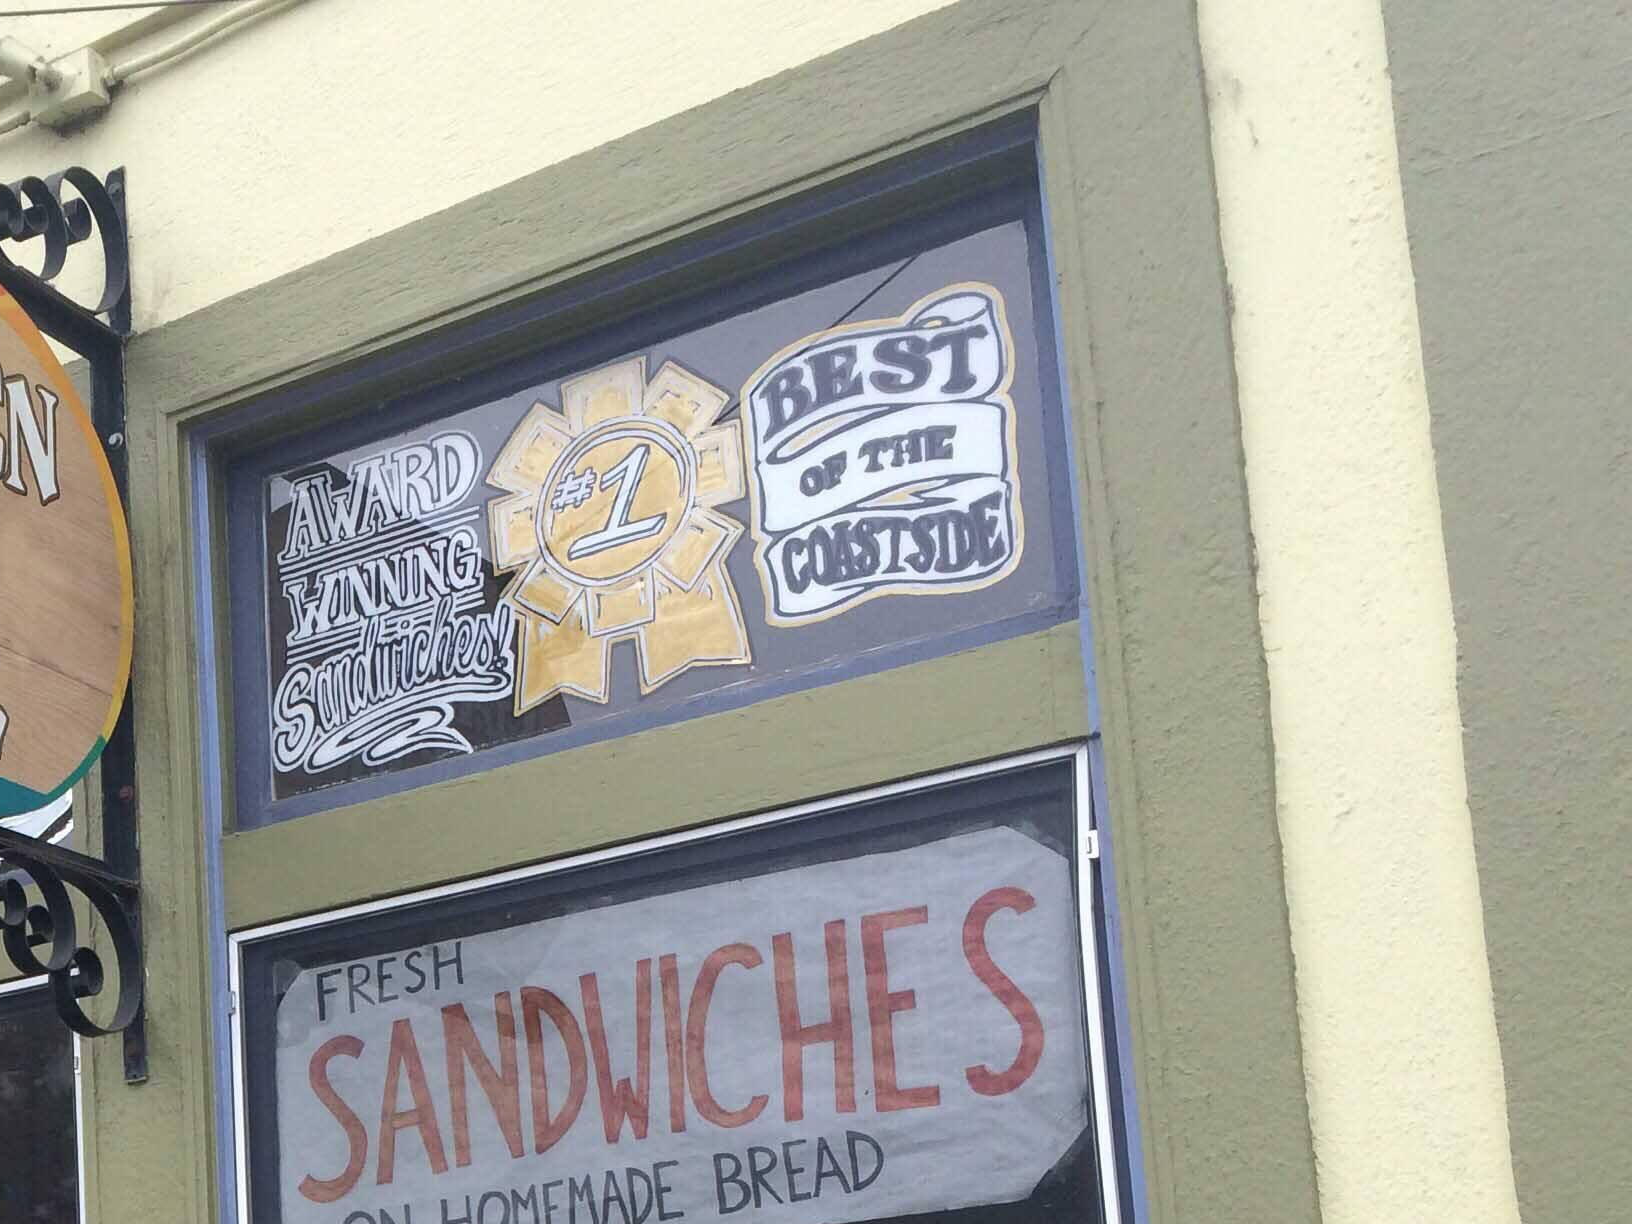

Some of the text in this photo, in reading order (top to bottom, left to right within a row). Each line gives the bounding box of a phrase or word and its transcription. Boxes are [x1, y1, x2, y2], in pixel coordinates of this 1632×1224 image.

[759, 324, 988, 443] BEST
[279, 432, 480, 562] AWARD
[551, 445, 668, 562] #1
[800, 425, 957, 496] OF THE
[285, 528, 483, 644] WINNING
[782, 491, 1005, 594] COASTSIDE
[317, 942, 465, 1021] FRESH
[298, 886, 1046, 1202] SANDWICHES
[714, 1130, 884, 1214] BREAD
